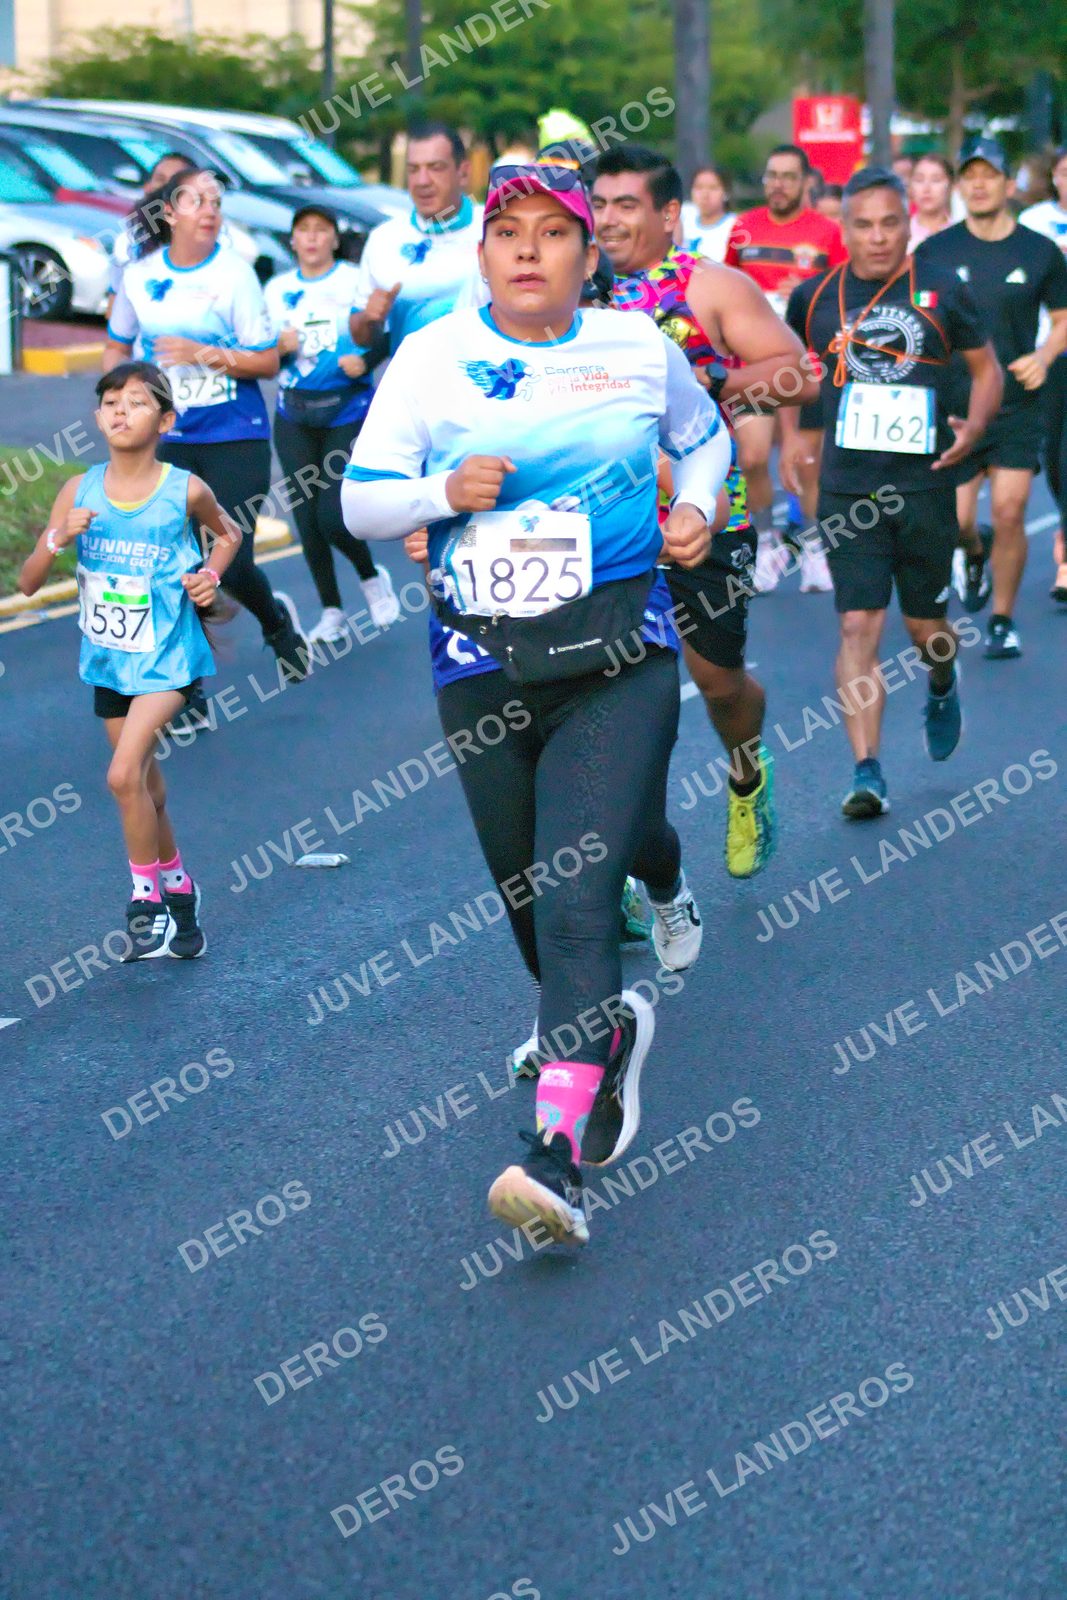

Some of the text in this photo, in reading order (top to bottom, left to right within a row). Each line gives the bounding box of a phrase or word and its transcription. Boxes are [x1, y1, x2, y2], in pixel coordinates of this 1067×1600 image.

[544, 365, 605, 375] Carrera
[582, 371, 609, 382] Vida
[178, 374, 225, 401] 575
[570, 379, 631, 392] Integridad
[853, 412, 924, 444] 1162
[461, 556, 583, 604] 1825
[557, 642, 584, 652] Samsung
